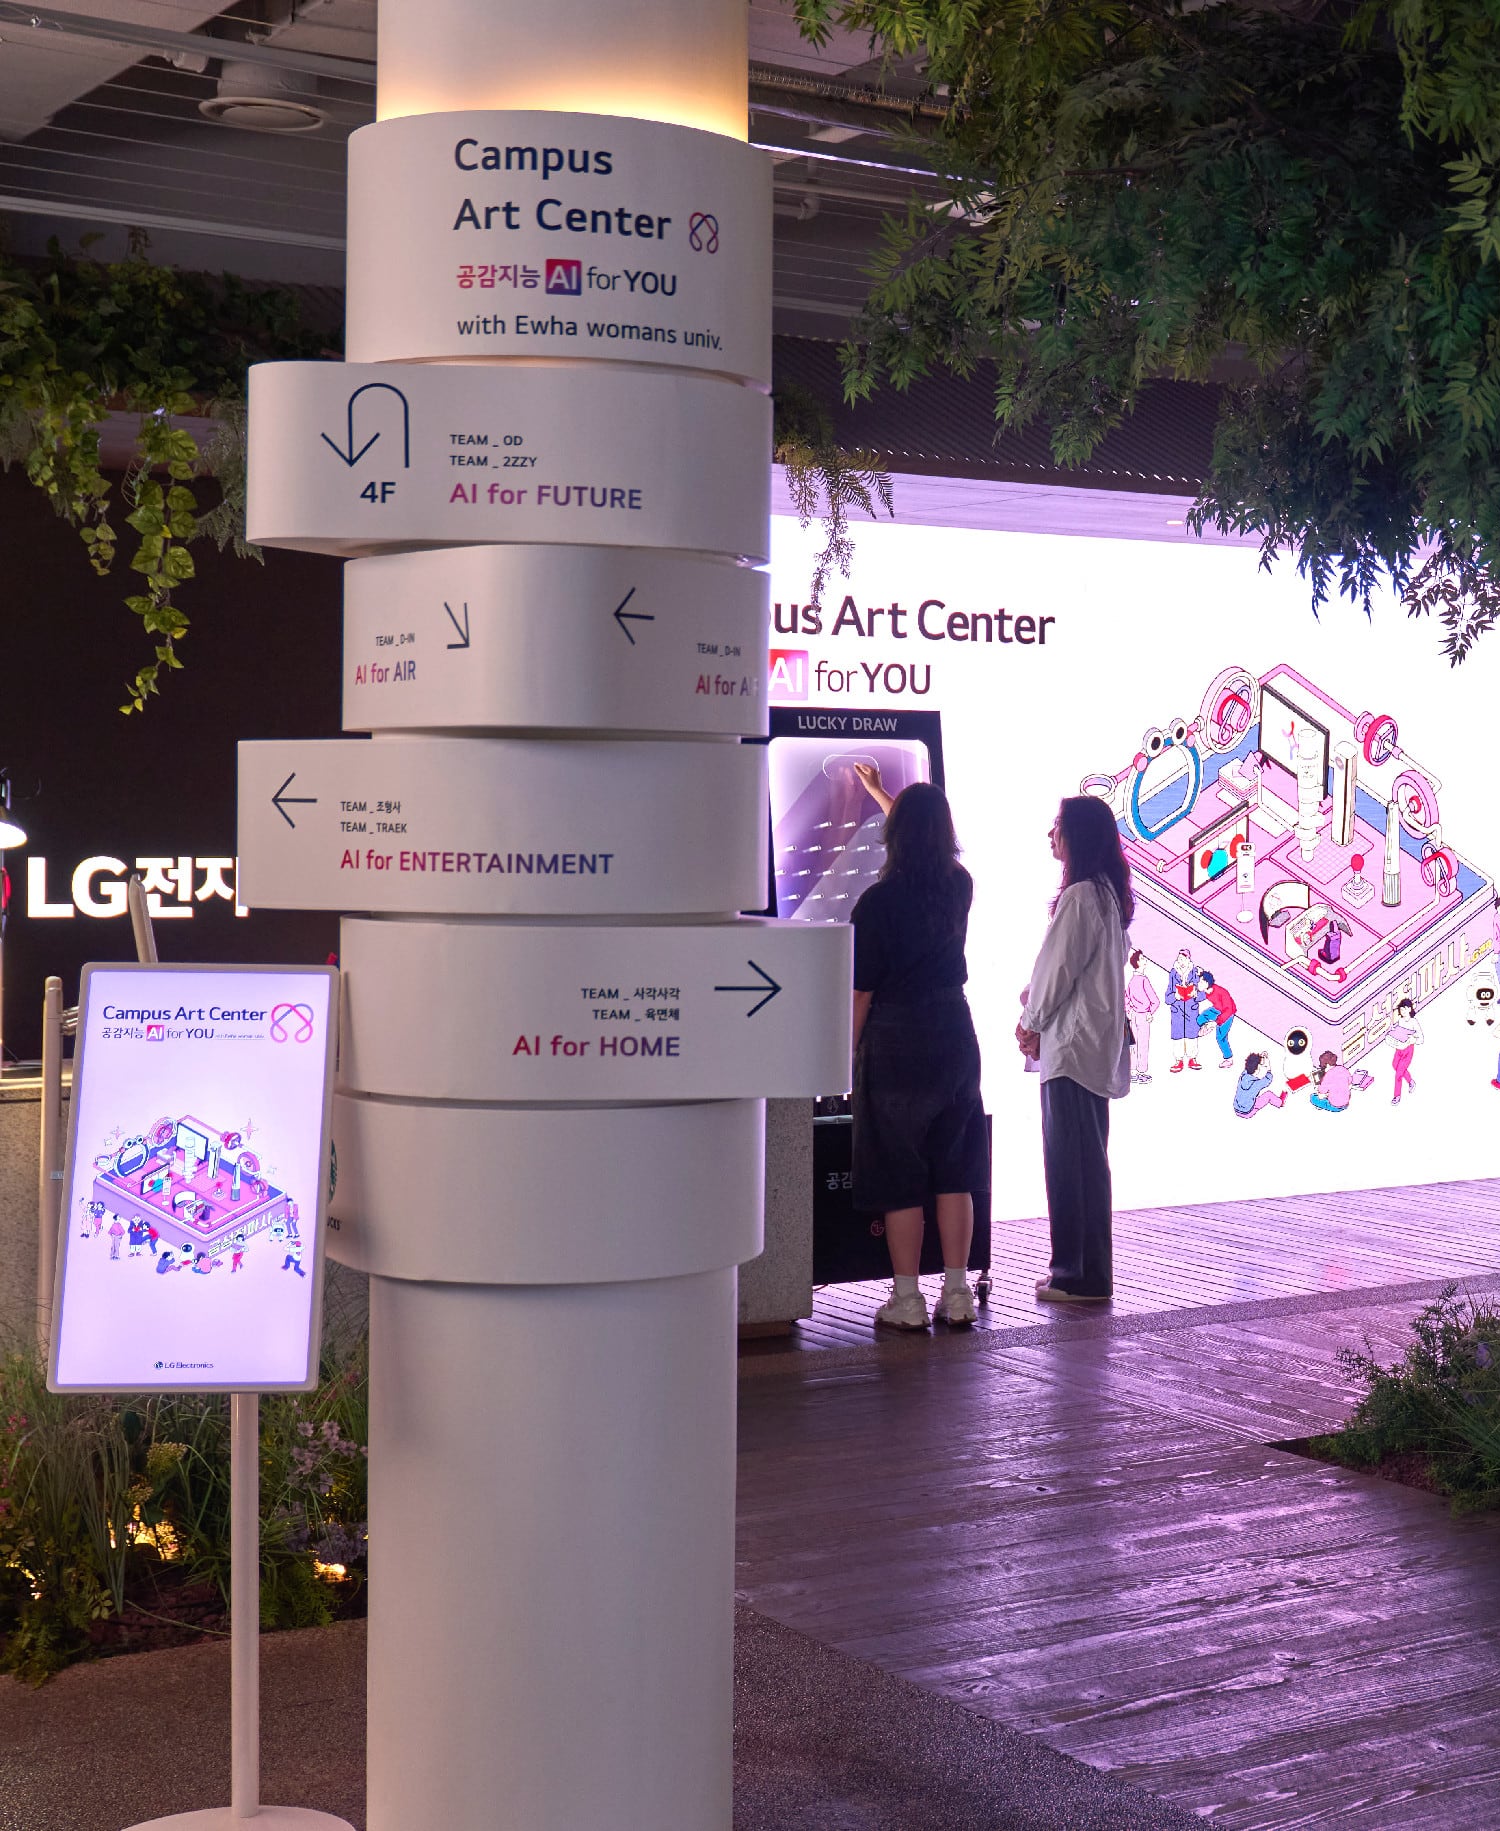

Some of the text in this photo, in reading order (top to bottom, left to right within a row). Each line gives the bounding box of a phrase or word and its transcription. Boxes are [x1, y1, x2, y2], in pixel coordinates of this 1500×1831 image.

[454, 138, 614, 180] Campus
[453, 198, 673, 241] Art Center
[456, 263, 678, 297] 공감지능 AI for YOU
[457, 315, 723, 351] with Ewha womans univ.
[449, 434, 489, 446] TEAM
[449, 455, 489, 467] TEAM
[503, 456, 537, 468] 2ZZY
[360, 482, 396, 504] 4F
[449, 482, 643, 510] AI for FUTURE
[768, 595, 1056, 645] us Art Center
[376, 635, 394, 646] TEAM
[696, 642, 719, 655] TEAM
[355, 659, 416, 685] AI for AIR
[768, 656, 932, 696] AI for YOU
[695, 673, 711, 694] AI
[715, 674, 736, 696] for
[797, 714, 898, 732] LUCKY DRAW
[340, 800, 367, 812] TEAM
[340, 821, 367, 833] TEAM
[340, 849, 614, 876] AI for ENTERTAINMENT
[581, 987, 619, 1000] TEAM
[633, 986, 681, 1001] 사각사각
[103, 1005, 268, 1024] Campus Art Center
[592, 1009, 631, 1021] TEAM
[101, 1026, 146, 1040] 공감지능
[147, 1026, 164, 1040] AI
[166, 1027, 184, 1040] for
[186, 1027, 215, 1040] YOU
[512, 1034, 681, 1058] AI for HOME
